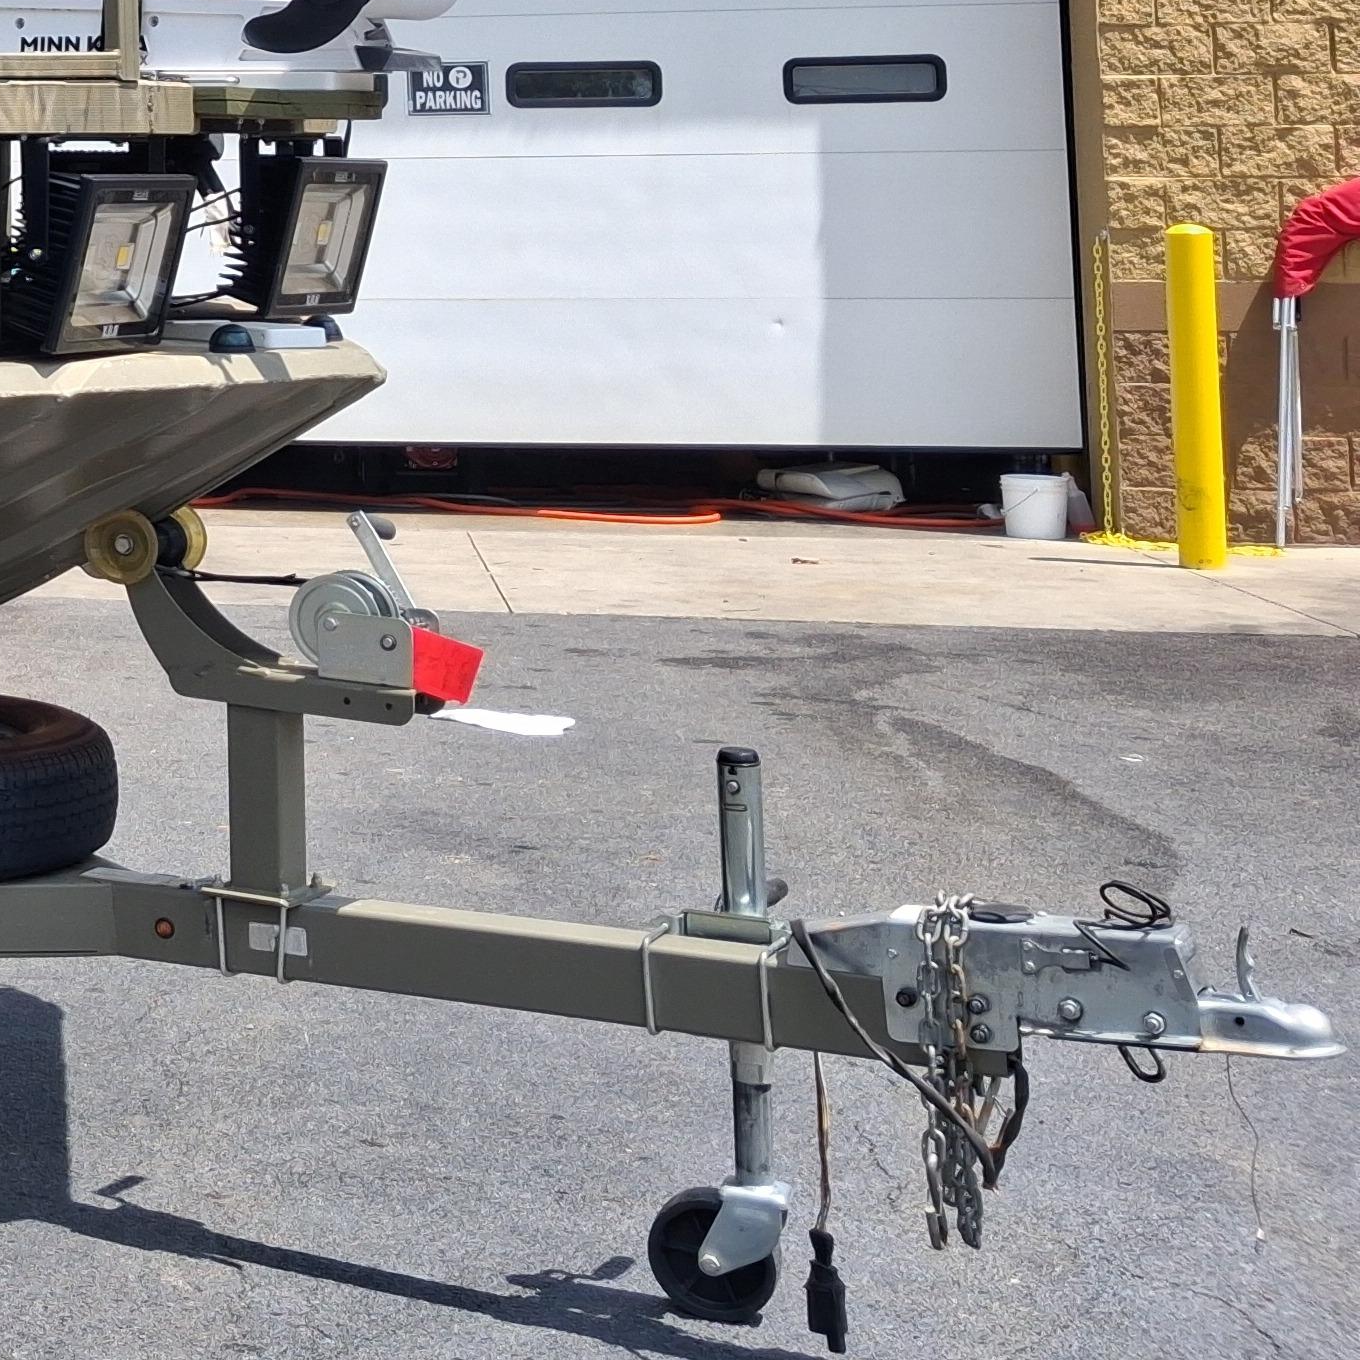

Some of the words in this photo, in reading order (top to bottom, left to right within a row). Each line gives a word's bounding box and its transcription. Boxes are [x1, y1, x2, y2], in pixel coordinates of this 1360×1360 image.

[20, 35, 81, 52] MINN
[423, 70, 444, 88] NO
[415, 90, 482, 110] PARKING
